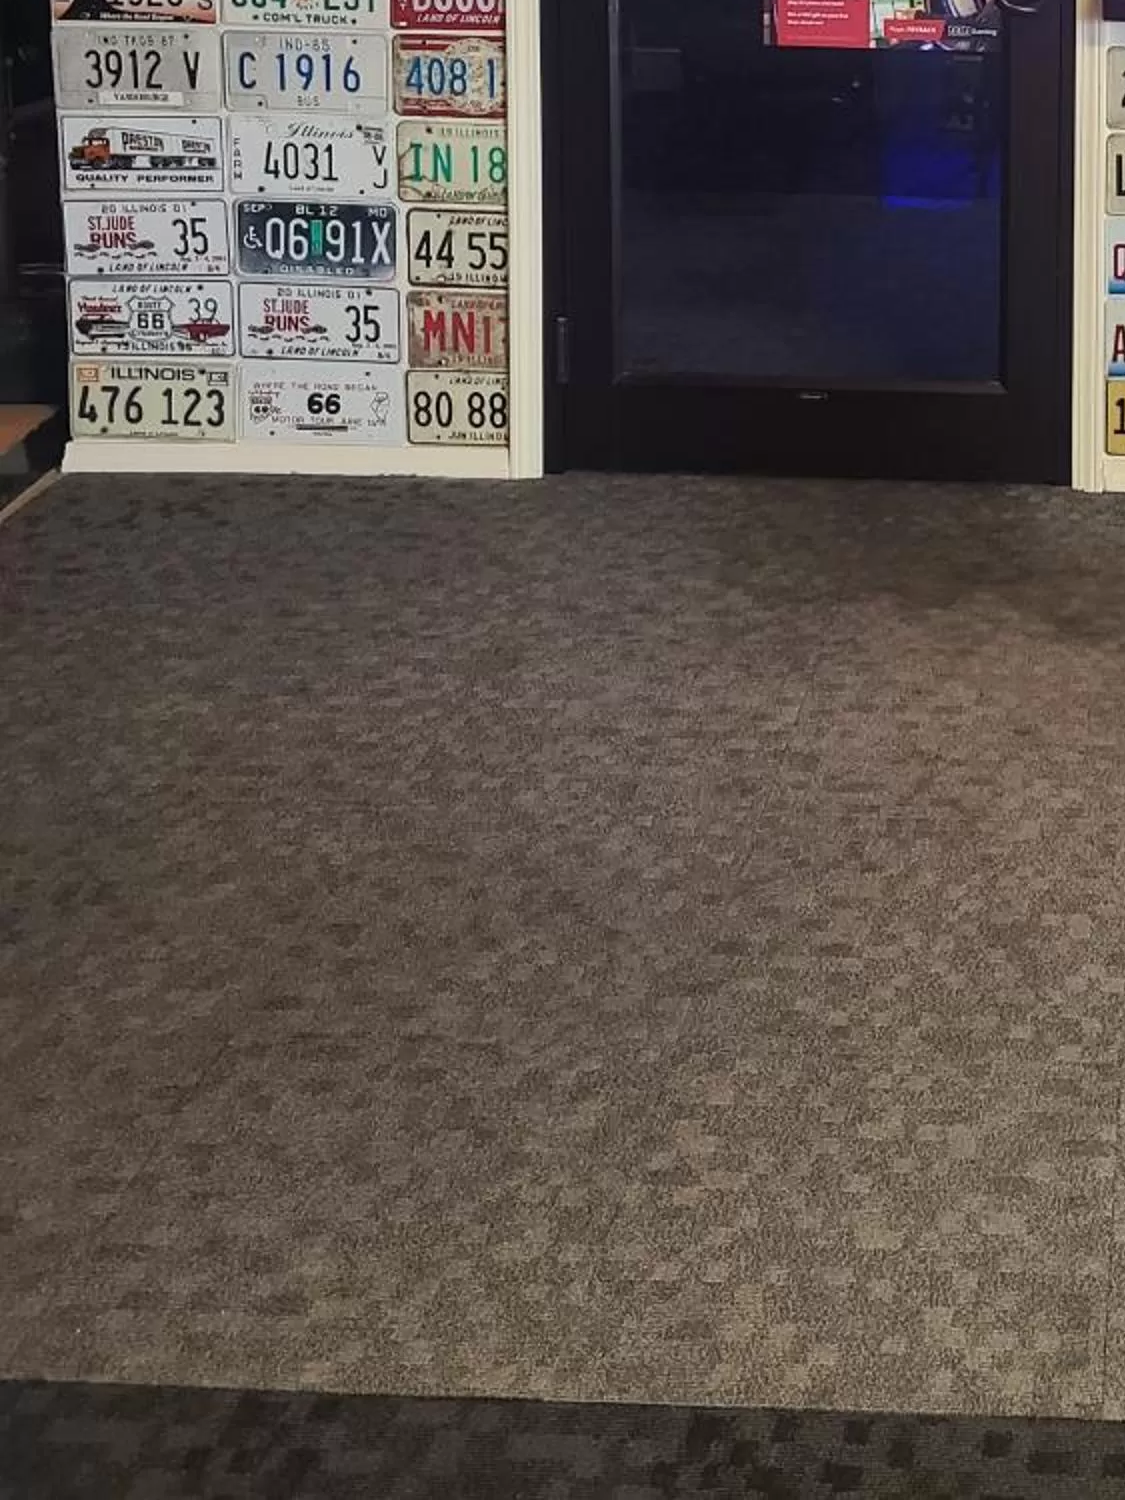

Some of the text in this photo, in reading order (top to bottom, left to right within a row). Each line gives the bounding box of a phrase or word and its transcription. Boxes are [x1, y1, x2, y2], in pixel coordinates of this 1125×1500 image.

[265, 144, 338, 181] 4031
[76, 174, 214, 183] QUALITY PERFORMER
[173, 218, 208, 256] 35
[109, 263, 131, 272] LAND
[147, 263, 188, 272] LINCOLN
[110, 368, 195, 380] ILLINOIS
[78, 386, 224, 427] 476 123
[307, 393, 341, 415] 66
